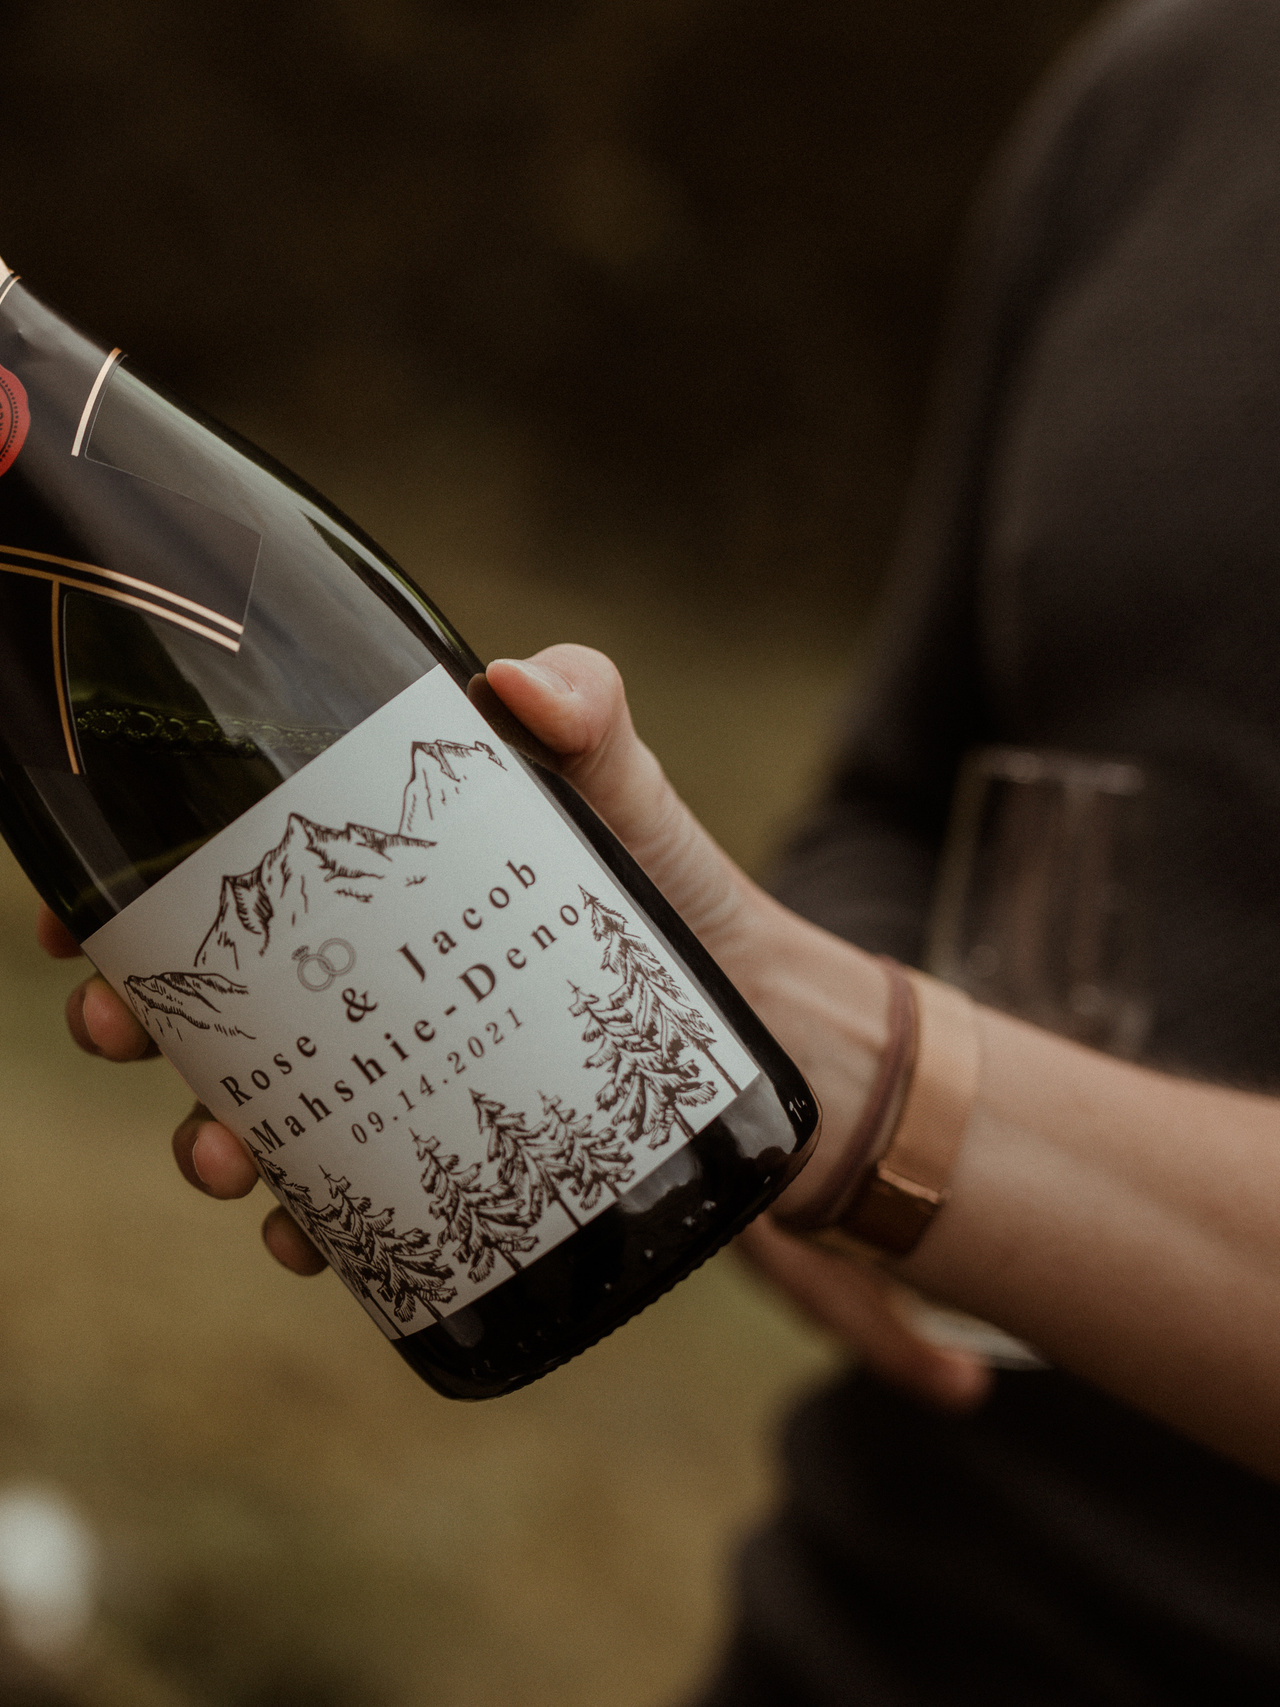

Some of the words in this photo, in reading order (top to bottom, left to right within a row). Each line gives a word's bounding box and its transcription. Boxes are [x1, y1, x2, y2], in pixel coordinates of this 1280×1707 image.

[220, 1035, 317, 1107] Rose
[341, 987, 378, 1022] &
[397, 859, 537, 982] Jacob
[250, 904, 579, 1154] Mahshie-Deno
[350, 1007, 524, 1145] 09.14.2021
